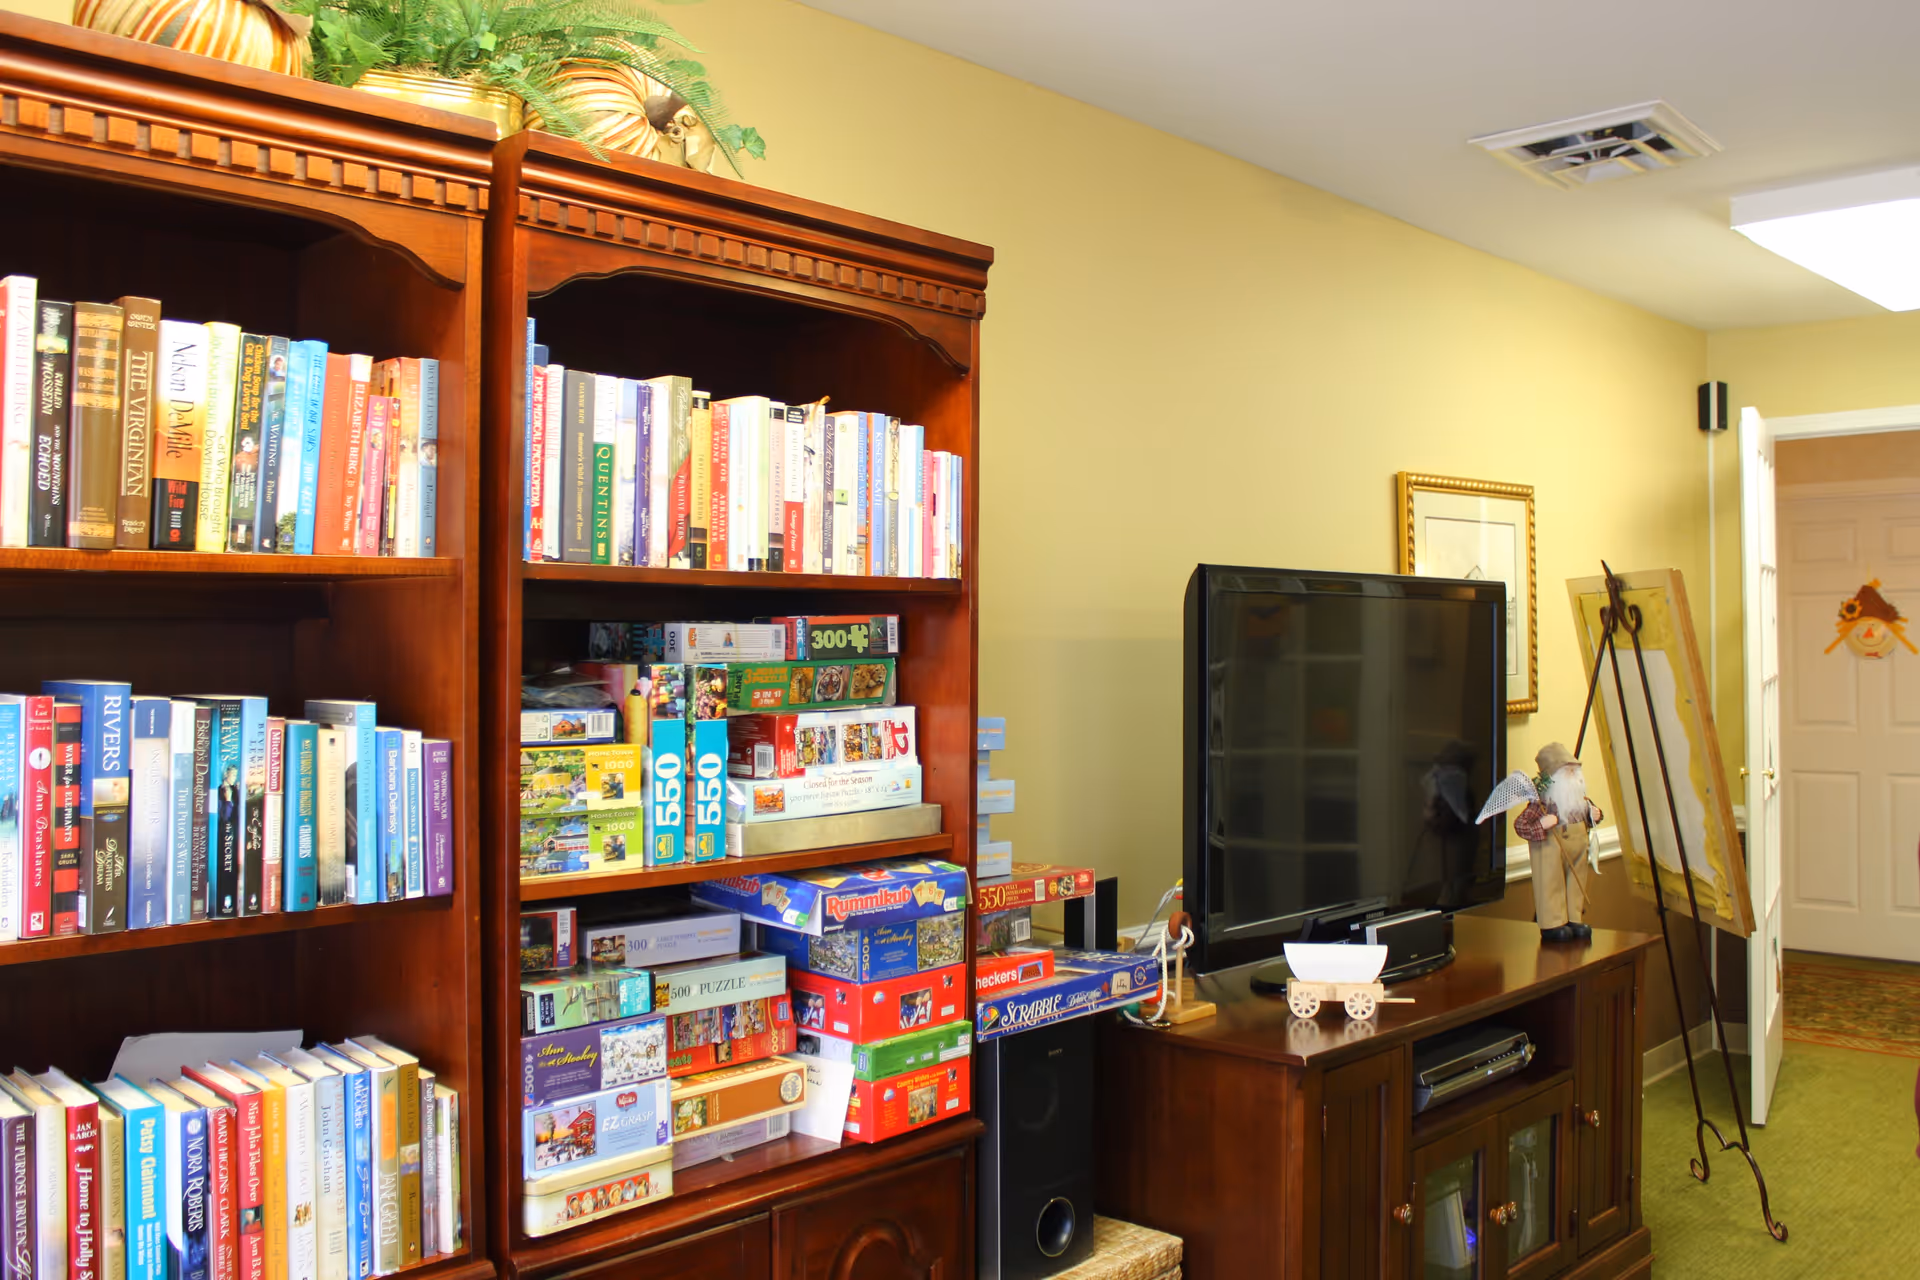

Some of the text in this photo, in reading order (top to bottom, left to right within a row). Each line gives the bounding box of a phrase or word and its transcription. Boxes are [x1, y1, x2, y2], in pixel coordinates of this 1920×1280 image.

[127, 320, 156, 332] WISTER
[130, 313, 153, 323] OWEN
[42, 361, 55, 416] HOSSEINI
[54, 372, 63, 409] KHALED
[166, 341, 198, 459] Nelson DeMille
[240, 343, 255, 430] Cat Dog Soul
[250, 344, 264, 423] Chicken Soup for the
[305, 354, 322, 454] THE IN OUR STARS
[535, 377, 545, 401] HOME
[126, 351, 149, 498] THE VIRGINIAN
[347, 384, 365, 475] ELIZABETH BERG
[533, 402, 544, 442] MEDICAL
[39, 435, 52, 490] ECHOED
[268, 424, 281, 467] WAITING
[712, 431, 720, 464] STONE
[719, 413, 729, 482] CUTTING FOR
[875, 432, 883, 464] KISSES
[51, 450, 63, 506] MOUNTAINS
[199, 429, 217, 521] Down House
[211, 457, 225, 534] Who Brought
[265, 480, 276, 504] Fisher
[531, 444, 543, 508] ENCYCLOPEDIA
[596, 447, 611, 539] QUENTINS
[343, 495, 354, 532] Say When
[677, 475, 686, 541] FRANCINE RIVERS
[711, 491, 720, 543] VERGHESE
[719, 493, 728, 541] ABRAHAM
[790, 510, 799, 531] Change
[811, 630, 848, 650] 300
[35, 709, 48, 717] Last
[753, 691, 761, 699] 3
[102, 695, 122, 772] RIVERS
[221, 718, 232, 763] LEWIS
[231, 717, 240, 763] BEVERLY
[257, 722, 265, 776] BEVERLY
[363, 727, 371, 757] JAMES
[64, 744, 74, 775] WATER
[194, 719, 210, 815] Bishop's Daughter
[249, 739, 257, 777] LEWIS
[270, 731, 281, 790] Mitch Albom
[388, 750, 398, 789] Barbara
[605, 760, 635, 770] 1000
[363, 759, 372, 814] PATTERSON
[433, 794, 441, 812] RIGHT
[440, 770, 448, 821] STARTING YOUR
[655, 752, 682, 827] 550
[697, 752, 723, 826] 550
[803, 775, 873, 790] Closed for the Season
[35, 780, 49, 888] Ann Brashares
[63, 790, 73, 843] ELEPHANTS
[176, 787, 189, 877] THE PILOT'S WIFE
[387, 791, 398, 835] Delinsky
[607, 821, 635, 832] 1000
[58, 858, 77, 866] GRUEN
[191, 826, 200, 892] BRUNSTETTER
[199, 826, 207, 860] WANDA
[223, 835, 233, 873] SECRET
[299, 824, 312, 859] CHAMBERS
[1, 851, 13, 908] Forbidden
[978, 885, 1006, 910] 550
[826, 884, 913, 922] Rummikub
[627, 938, 648, 953] 300
[862, 944, 870, 971] 500
[670, 977, 746, 1001] 500 PUZZLE
[975, 969, 1018, 990] heckers
[1001, 994, 1063, 1027] SCRABBLE
[425, 1083, 434, 1103] Daily
[524, 1065, 534, 1093] 500
[354, 1078, 365, 1130] MACOMBER
[426, 1104, 435, 1138] Devotions
[602, 1110, 655, 1132] EZ GRASP
[70, 1130, 97, 1142] KARON
[77, 1122, 92, 1132] JAN
[140, 1118, 156, 1154] Patsy
[335, 1092, 345, 1162] PAINTED
[426, 1138, 436, 1149] for
[244, 1101, 262, 1202] Miss Julia Takes Over
[321, 1105, 332, 1195] John Grisham
[15, 1121, 27, 1249] THE PURPOSE DRIVEN
[140, 1156, 157, 1220] Clairmont
[183, 1136, 205, 1232] NORA ROBERTS
[217, 1112, 230, 1240] MARY HIGGINS CLARK
[335, 1164, 345, 1217] HOUSE
[75, 1163, 94, 1267] Home to Holly
[111, 1179, 120, 1218] BROWN
[380, 1171, 398, 1247] JANE GREEN
[226, 1245, 233, 1260] ON
[250, 1236, 262, 1269] Ann B.
